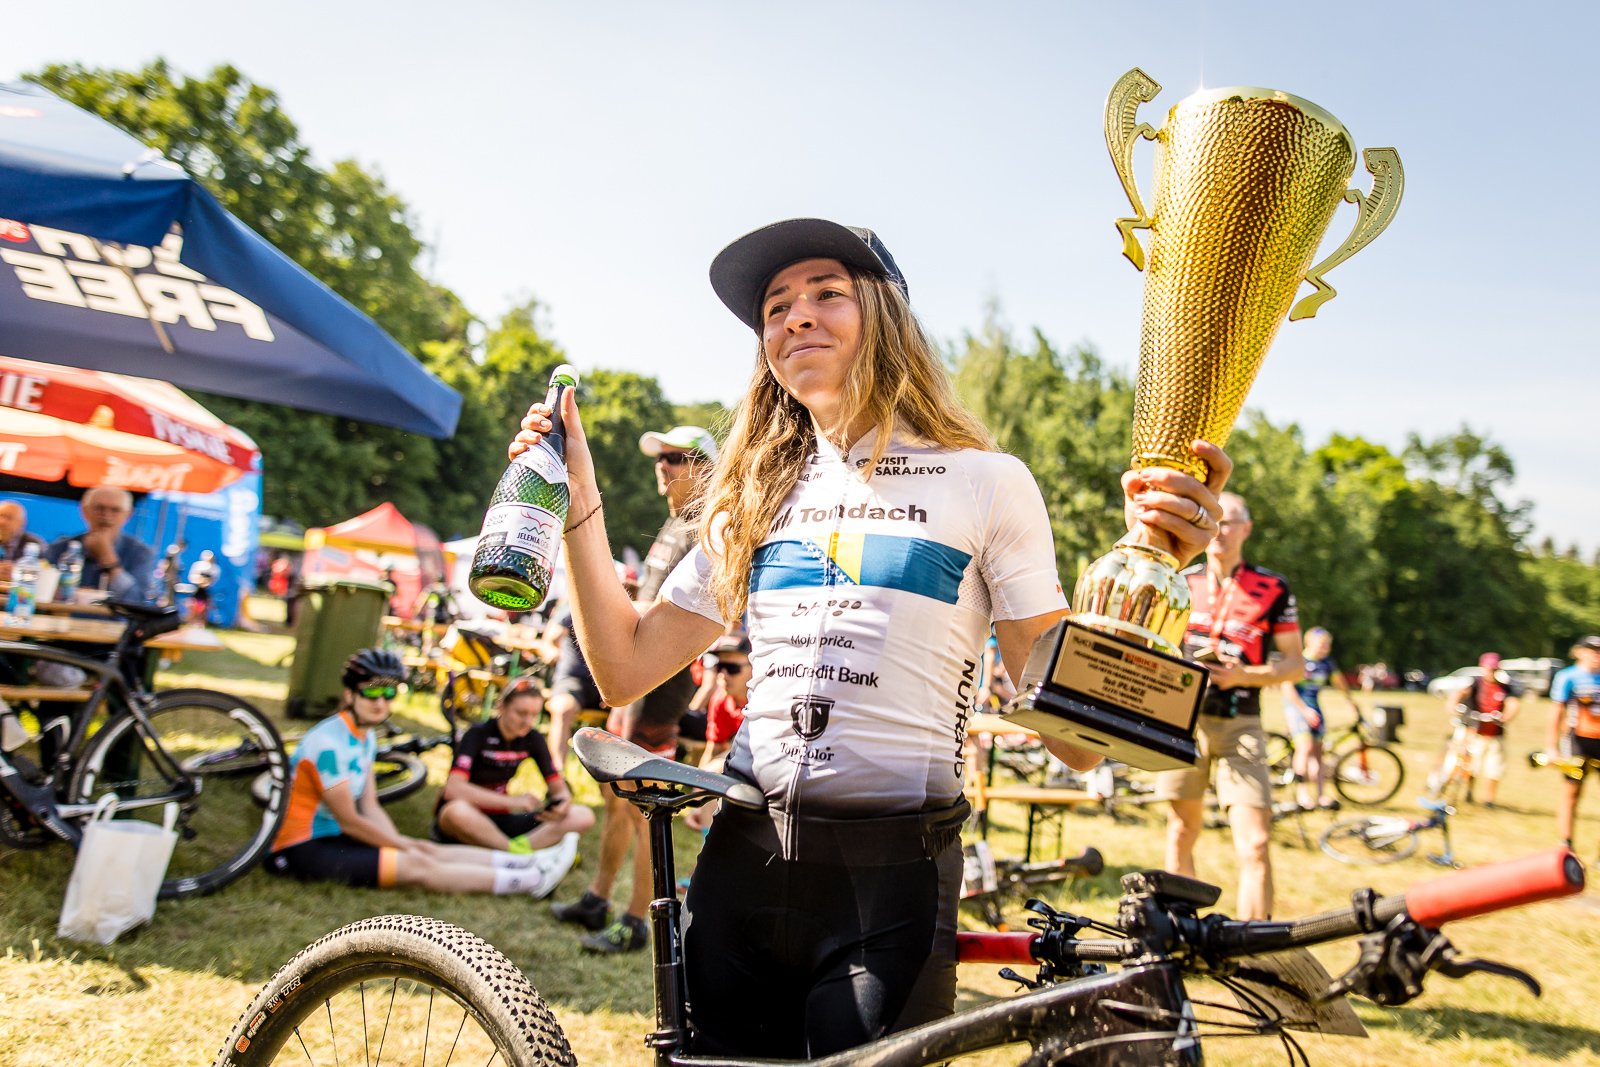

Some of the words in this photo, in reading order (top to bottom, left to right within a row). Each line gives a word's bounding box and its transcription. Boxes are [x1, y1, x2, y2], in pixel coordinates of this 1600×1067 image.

[877, 457, 908, 465] VISIT
[875, 467, 946, 476] SARAJEVO
[800, 503, 927, 523] Tondach
[819, 635, 855, 649] priča.
[838, 667, 879, 688] Bank
[266, 994, 281, 1010] EXO
